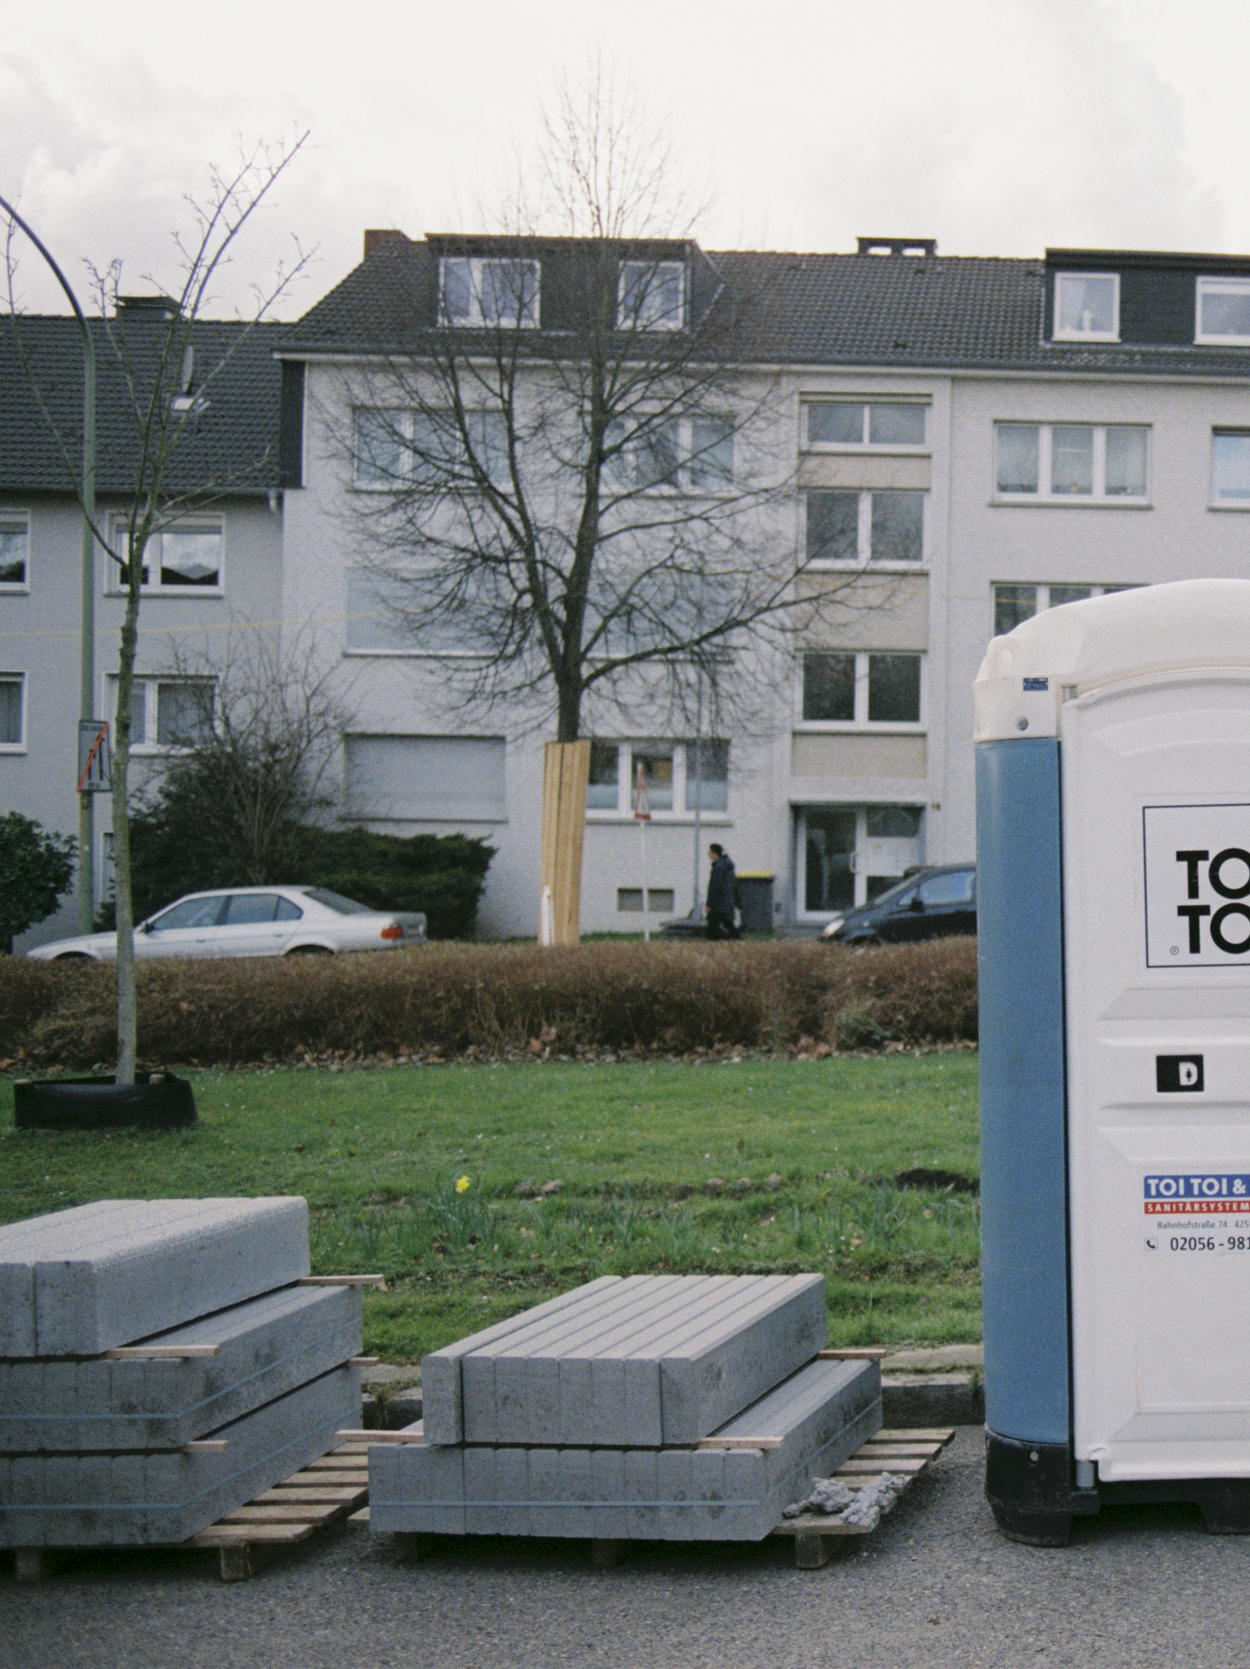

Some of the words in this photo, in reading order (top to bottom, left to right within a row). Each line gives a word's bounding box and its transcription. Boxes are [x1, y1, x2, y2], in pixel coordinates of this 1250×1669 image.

[1147, 1178, 1185, 1196] TOI
[1190, 1177, 1228, 1195] TOI
[1232, 1178, 1247, 1195] &
[1157, 1220, 1216, 1230] Bahnhofstraße
[1218, 1220, 1228, 1229] 74
[1170, 1237, 1215, 1251] 02056
